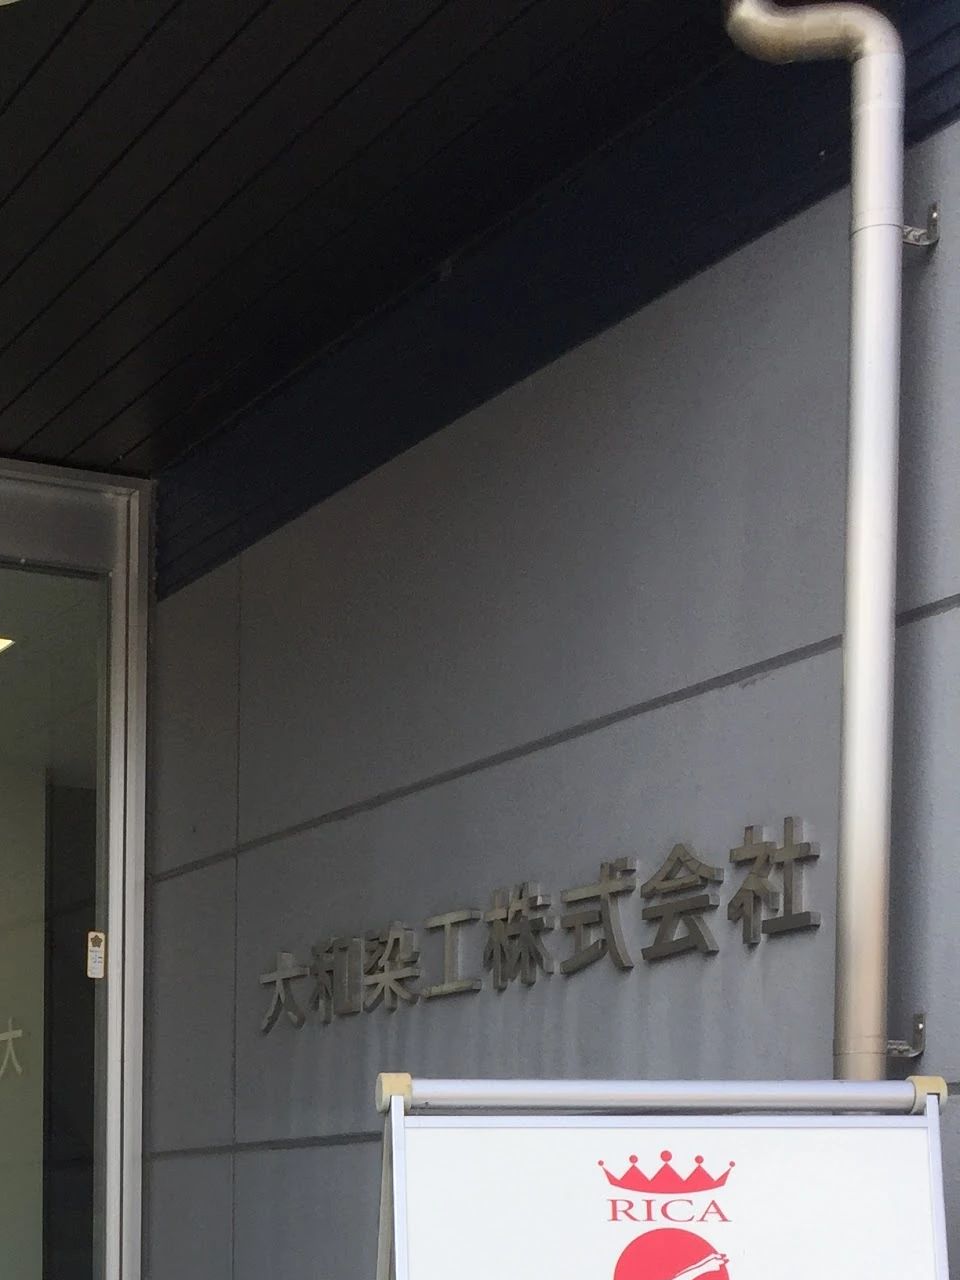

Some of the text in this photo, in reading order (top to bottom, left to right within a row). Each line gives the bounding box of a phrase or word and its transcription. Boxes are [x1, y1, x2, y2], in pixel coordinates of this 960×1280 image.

[259, 816, 821, 1034] 大和染工株式会社
[607, 1198, 732, 1223] RICA
